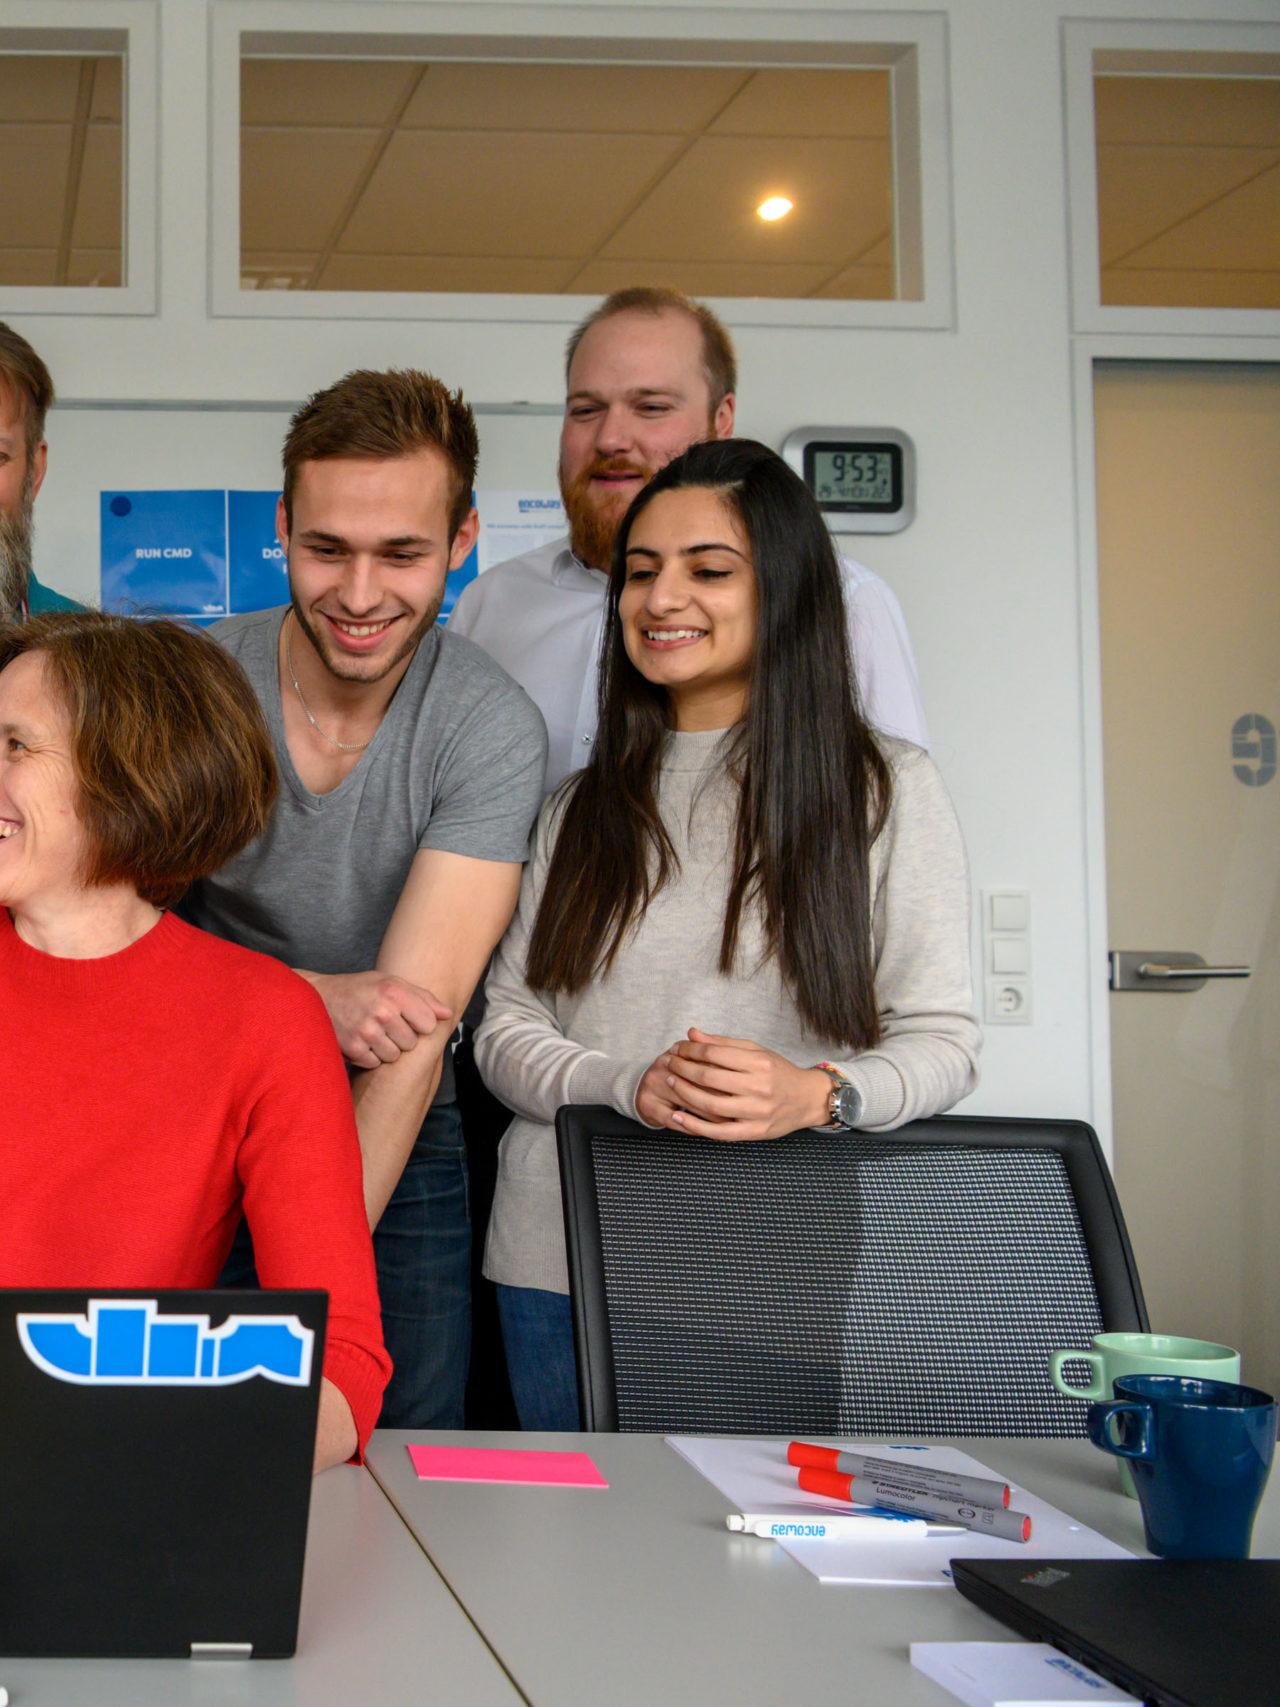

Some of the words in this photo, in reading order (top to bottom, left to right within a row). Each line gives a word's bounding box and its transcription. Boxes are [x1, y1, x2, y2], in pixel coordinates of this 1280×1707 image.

[135, 548, 161, 559] RUN
[163, 548, 193, 559] CMD
[876, 1487, 916, 1501] Lumocolor
[771, 1524, 826, 1537] encoway
